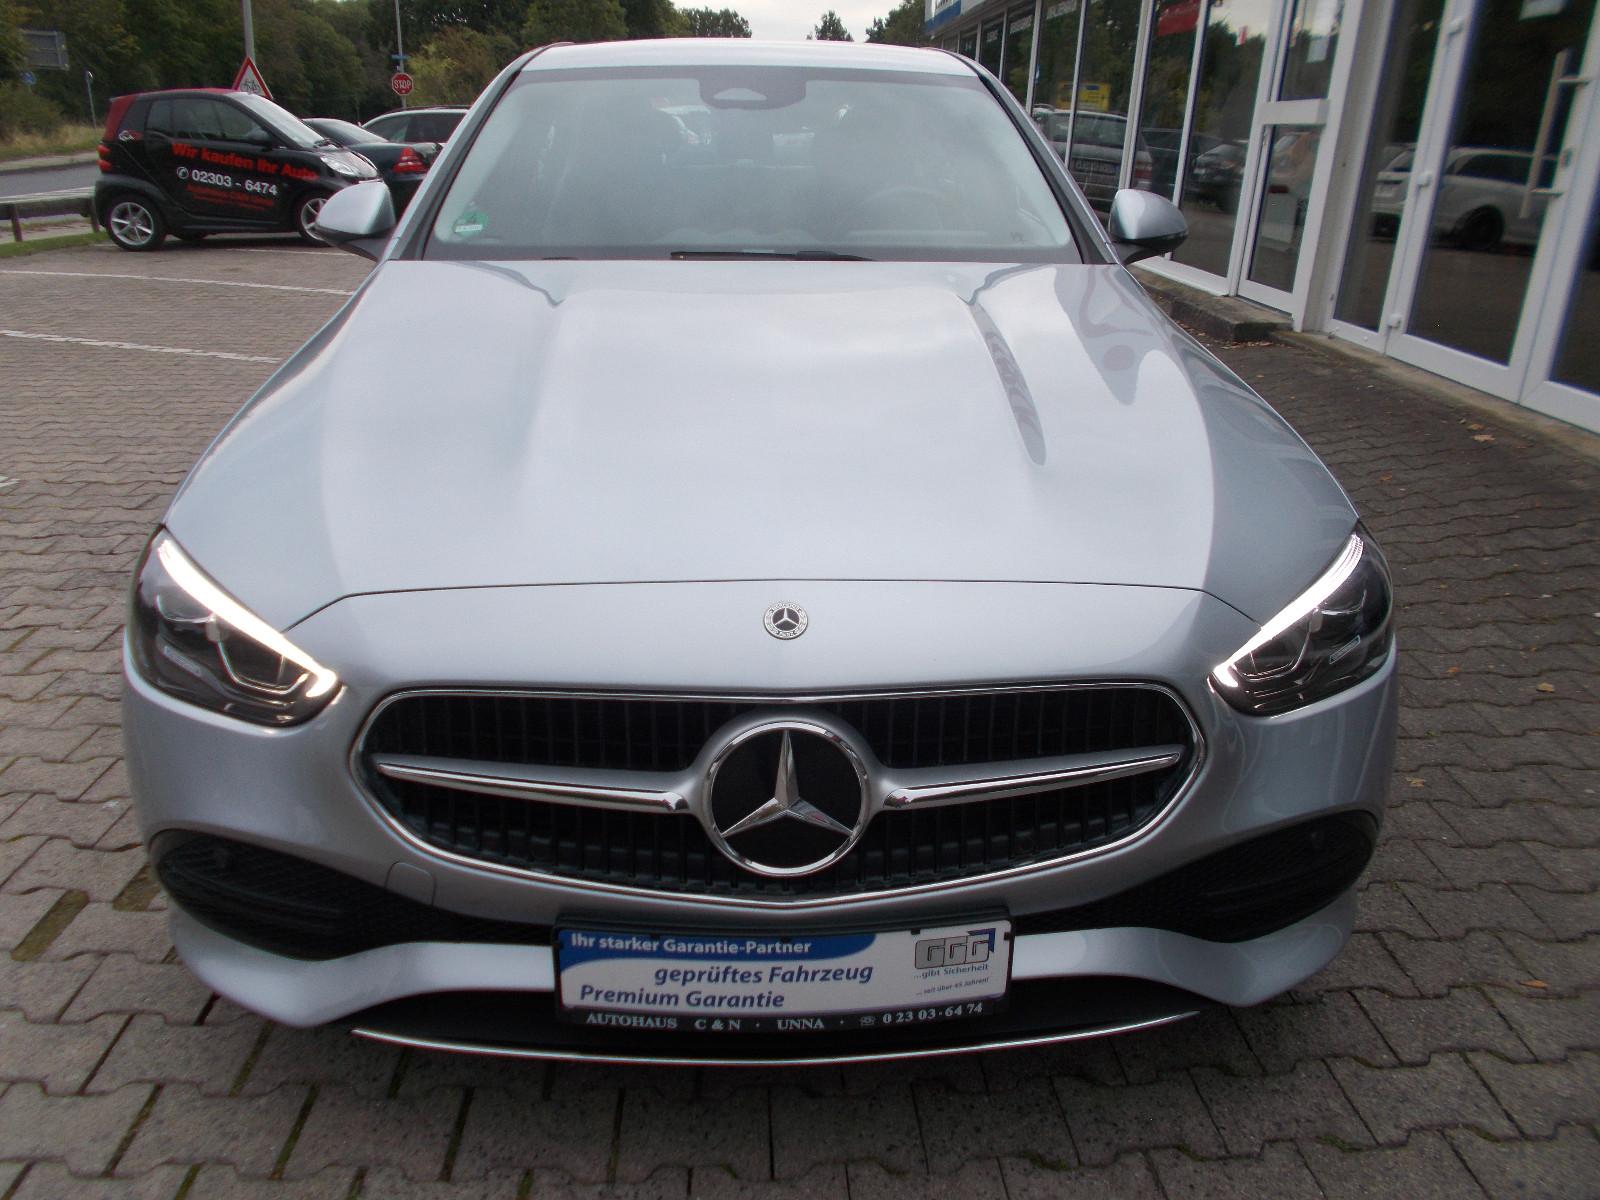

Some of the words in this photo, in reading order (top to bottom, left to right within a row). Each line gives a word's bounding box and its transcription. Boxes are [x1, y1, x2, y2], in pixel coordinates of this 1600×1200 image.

[393, 79, 411, 89] STOP
[172, 142, 197, 159] Wir
[201, 148, 253, 169] kaufen
[257, 158, 278, 175] Ihr
[191, 169, 232, 188] 02303
[244, 179, 278, 196] 6474
[571, 933, 594, 947] Ihr
[599, 936, 660, 952] starker
[663, 939, 812, 954] Garantie-Partner
[655, 966, 763, 986] geprüftes
[768, 965, 874, 984] Fahrzeug
[944, 963, 989, 976] Sicherheit
[580, 984, 680, 1007] Premium
[685, 990, 785, 1008] Garantie
[586, 1013, 679, 1030] AUTOHAUS
[694, 1019, 707, 1031] C
[711, 1018, 725, 1031] &
[728, 1019, 741, 1031] N
[776, 1019, 825, 1031] UNNA
